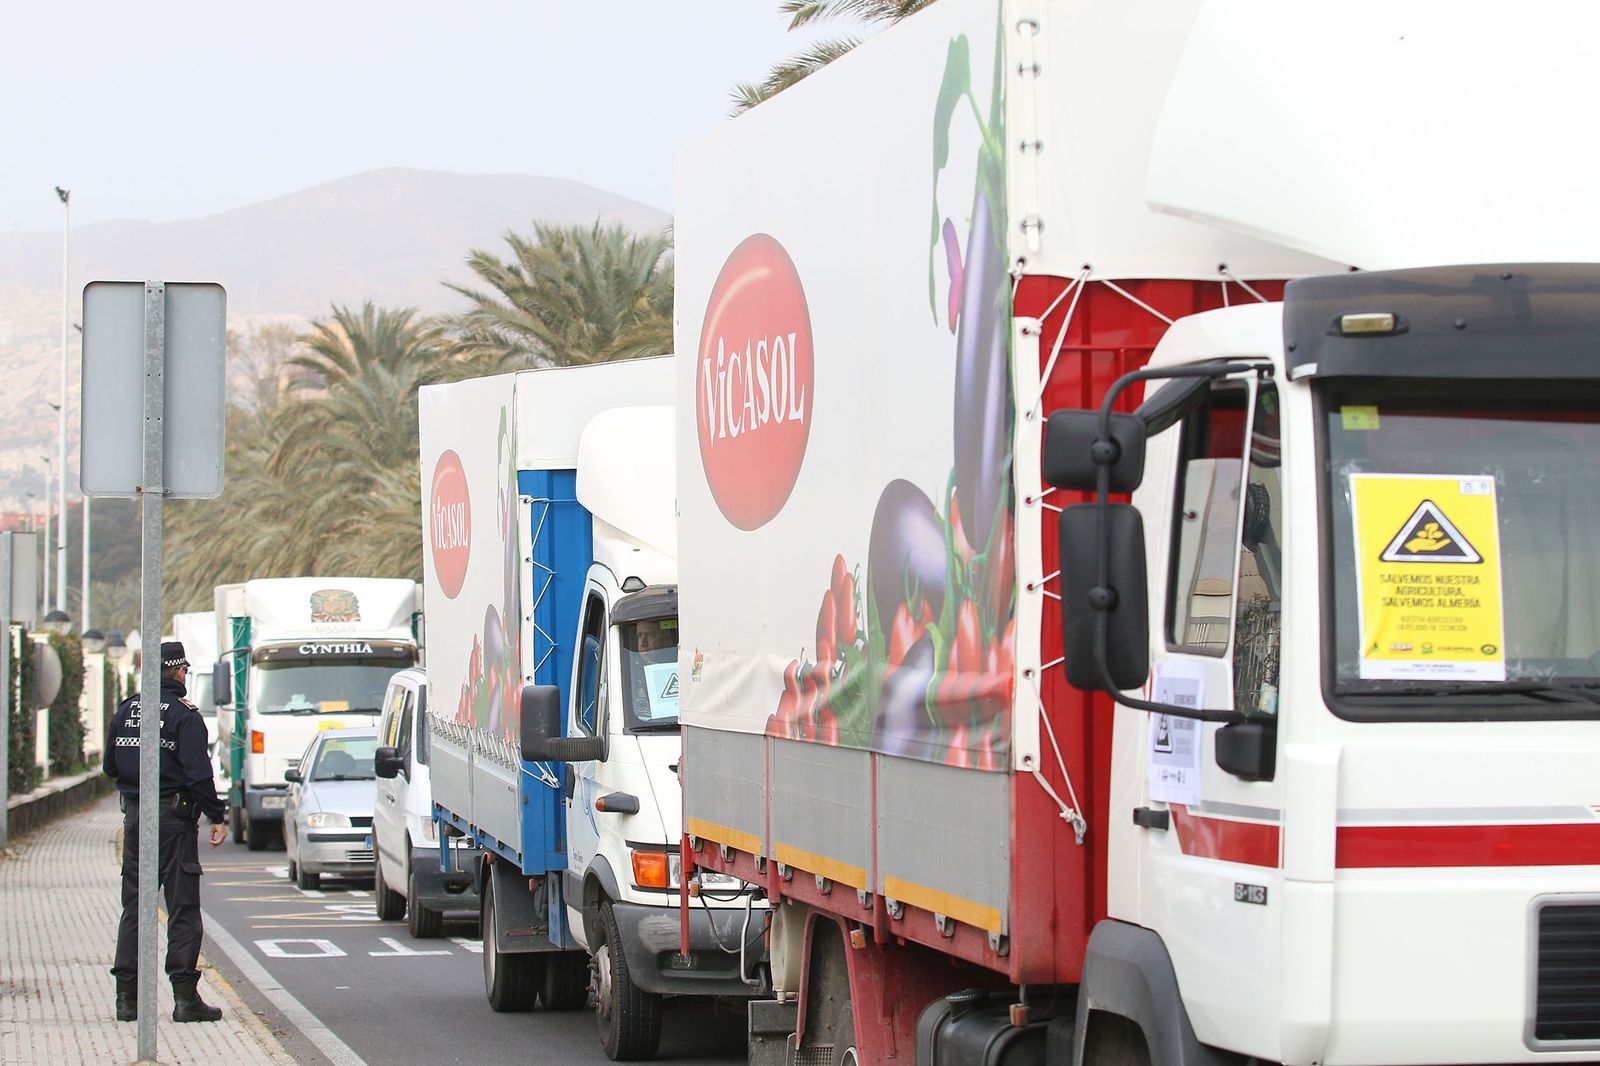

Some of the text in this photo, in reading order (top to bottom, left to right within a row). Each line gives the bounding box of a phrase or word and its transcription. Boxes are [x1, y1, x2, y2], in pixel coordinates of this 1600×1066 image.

[1379, 574, 1481, 585] SALVEMOS NUESTRA
[1382, 597, 1435, 608] SALVEMOS
[299, 643, 374, 655] CYNTHIA
